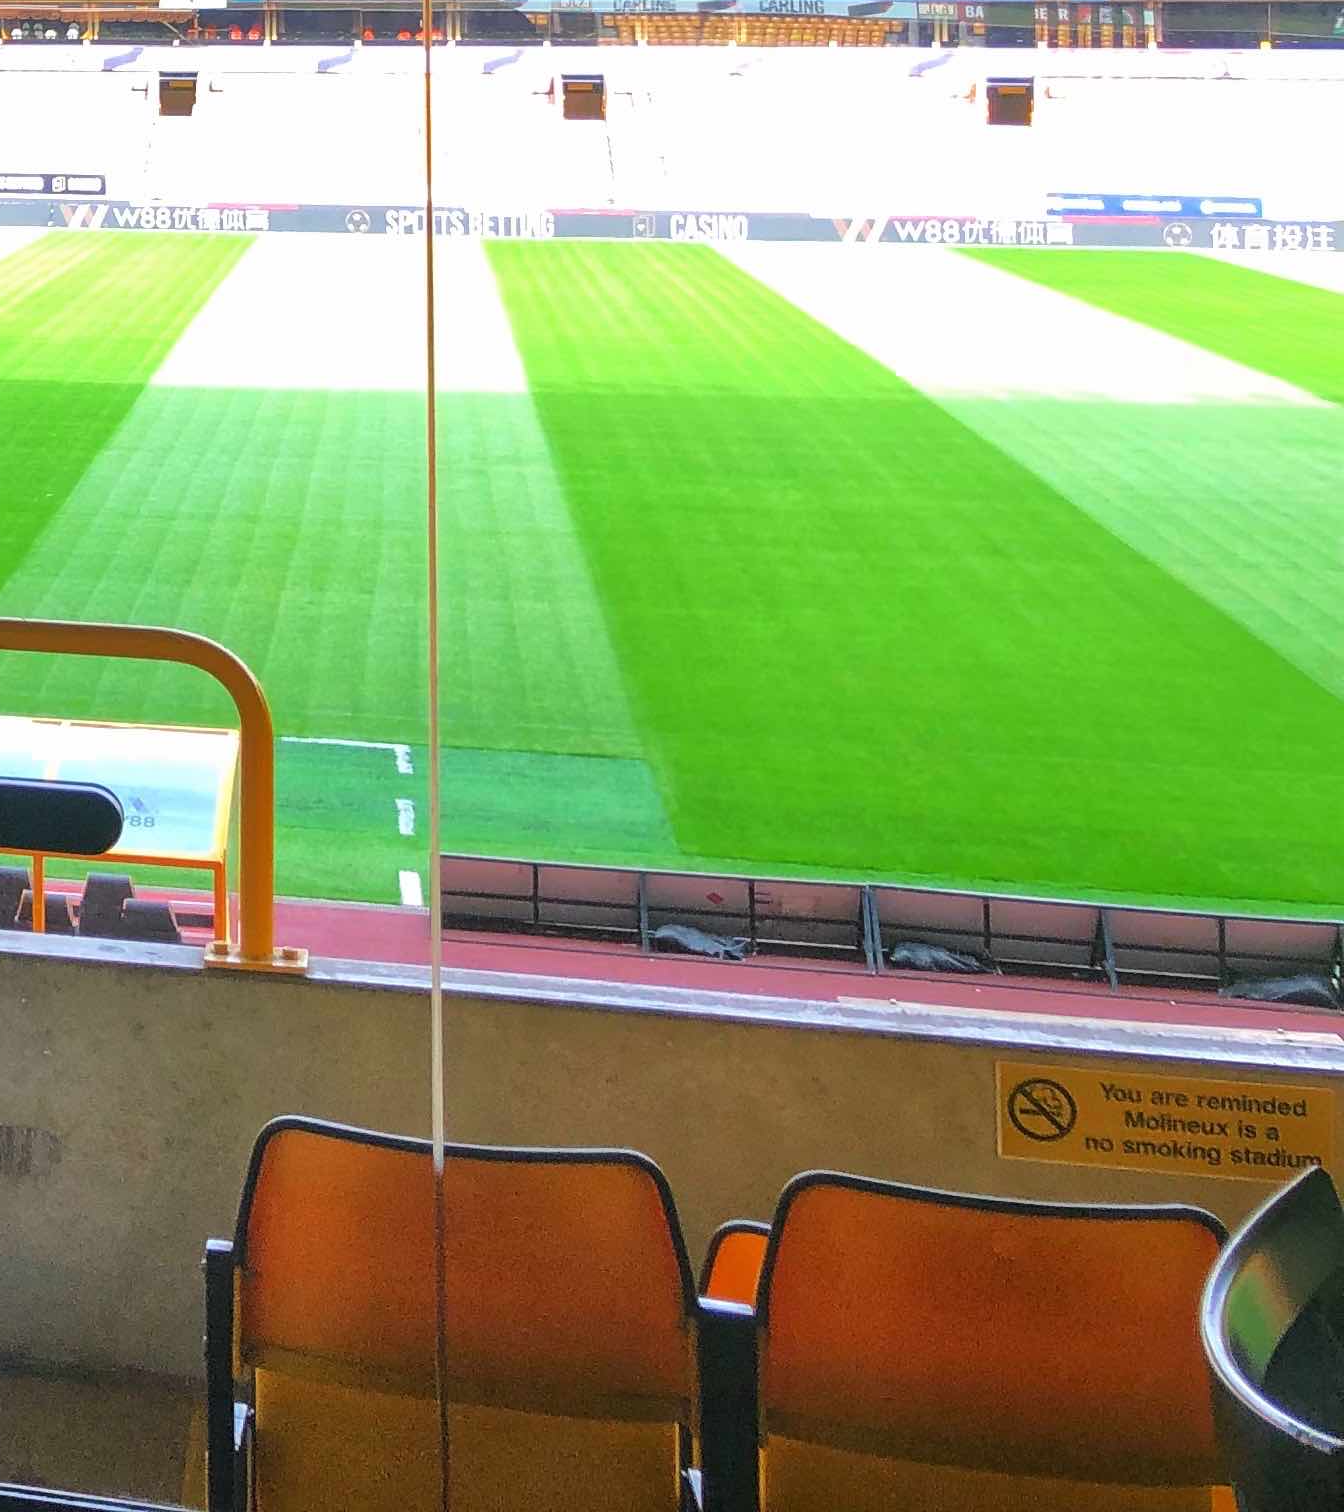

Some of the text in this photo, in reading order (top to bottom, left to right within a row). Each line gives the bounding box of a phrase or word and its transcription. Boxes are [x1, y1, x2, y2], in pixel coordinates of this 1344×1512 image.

[759, 0, 825, 14] CARLING
[670, 214, 749, 240] CASINO
[123, 815, 155, 828] 88
[1100, 1081, 1307, 1118] You are reminded
[1124, 1110, 1280, 1140] Molineux is a
[1085, 1136, 1322, 1168] no smoking stadium
